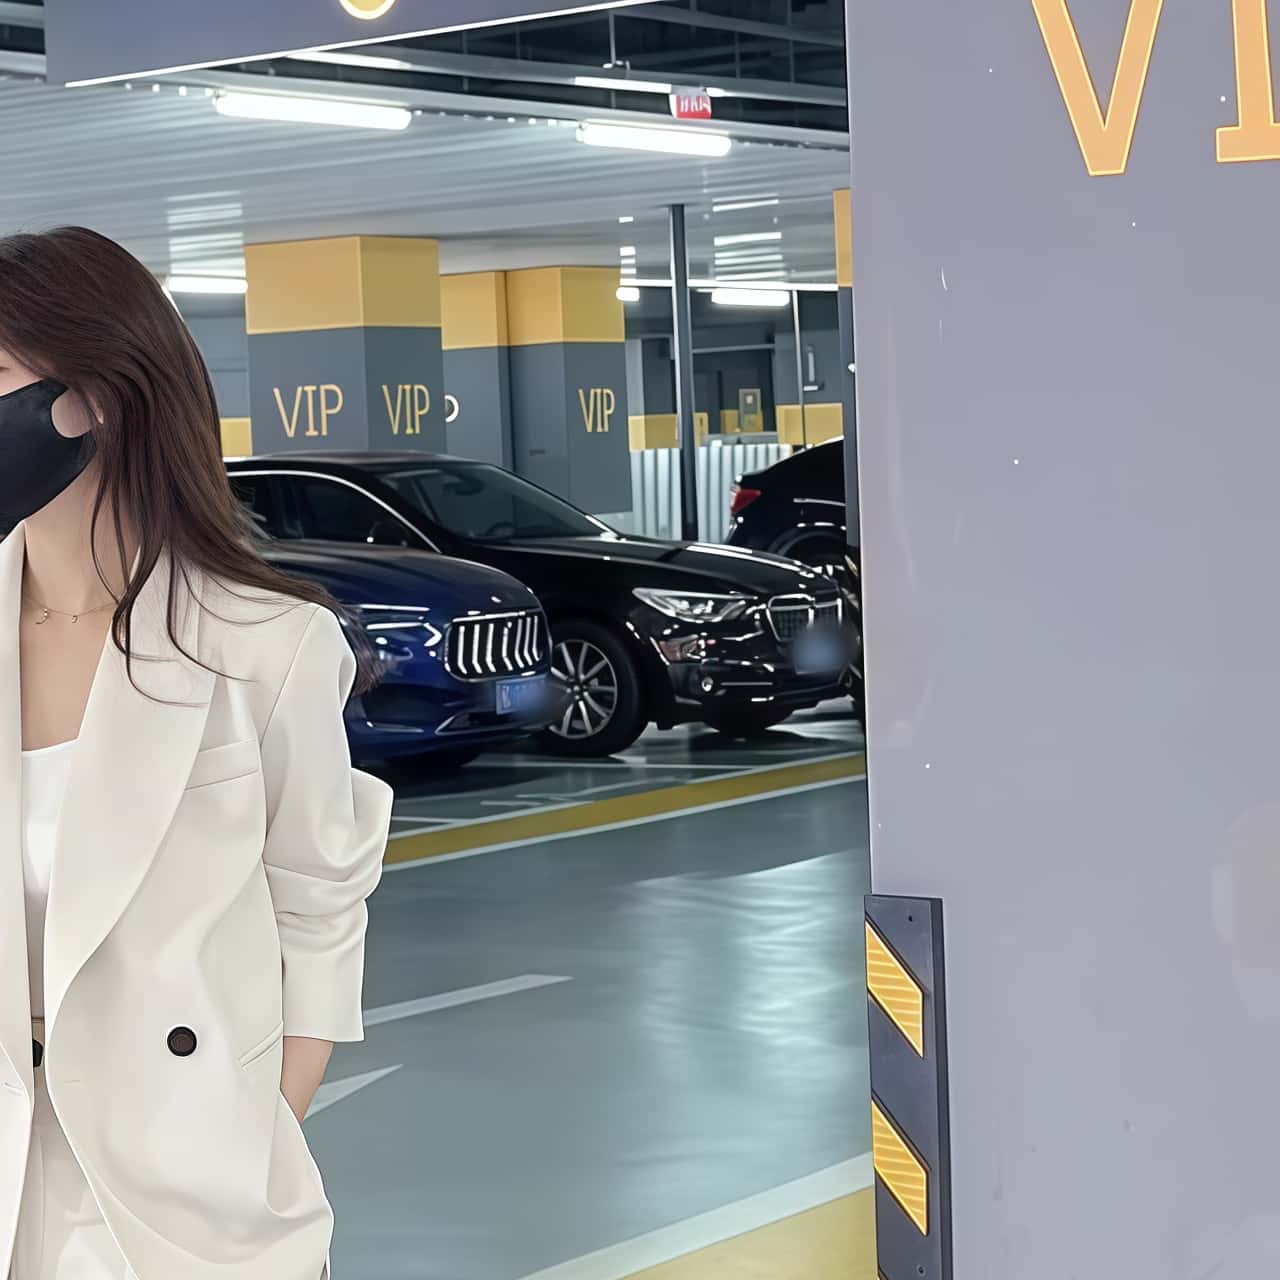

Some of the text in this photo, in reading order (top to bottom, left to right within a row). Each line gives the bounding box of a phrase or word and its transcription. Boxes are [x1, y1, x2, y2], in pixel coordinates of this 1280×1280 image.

[273, 384, 344, 438] VIP
[382, 384, 430, 435] VIP
[578, 388, 616, 433] VIP
